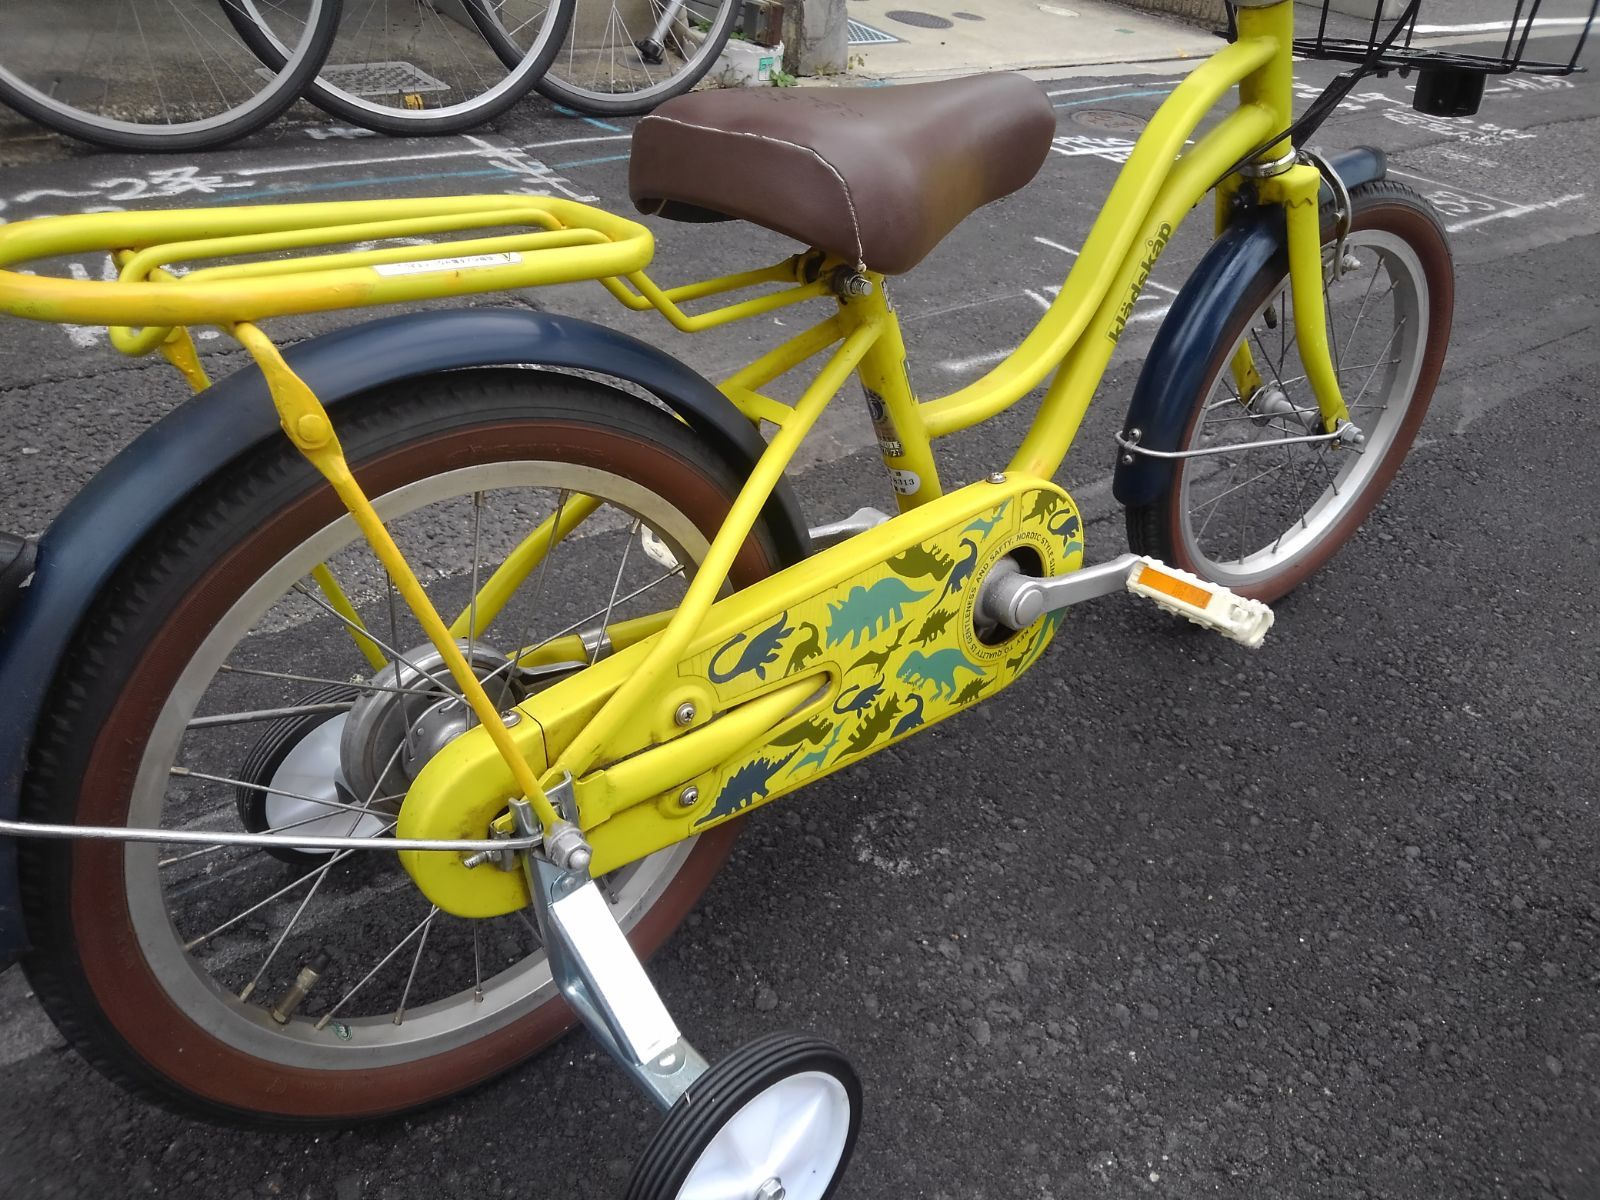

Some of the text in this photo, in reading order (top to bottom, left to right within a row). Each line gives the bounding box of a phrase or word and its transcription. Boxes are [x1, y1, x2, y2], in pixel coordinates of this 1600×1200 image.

[1016, 531, 1041, 542] NORDIC
[1040, 537, 1054, 558] STYLE
[976, 563, 989, 583] AND
[964, 587, 977, 642] GENTLENESS
[970, 643, 978, 653] IS
[1004, 645, 1014, 654] TO
[975, 649, 1002, 660] QUALITY
